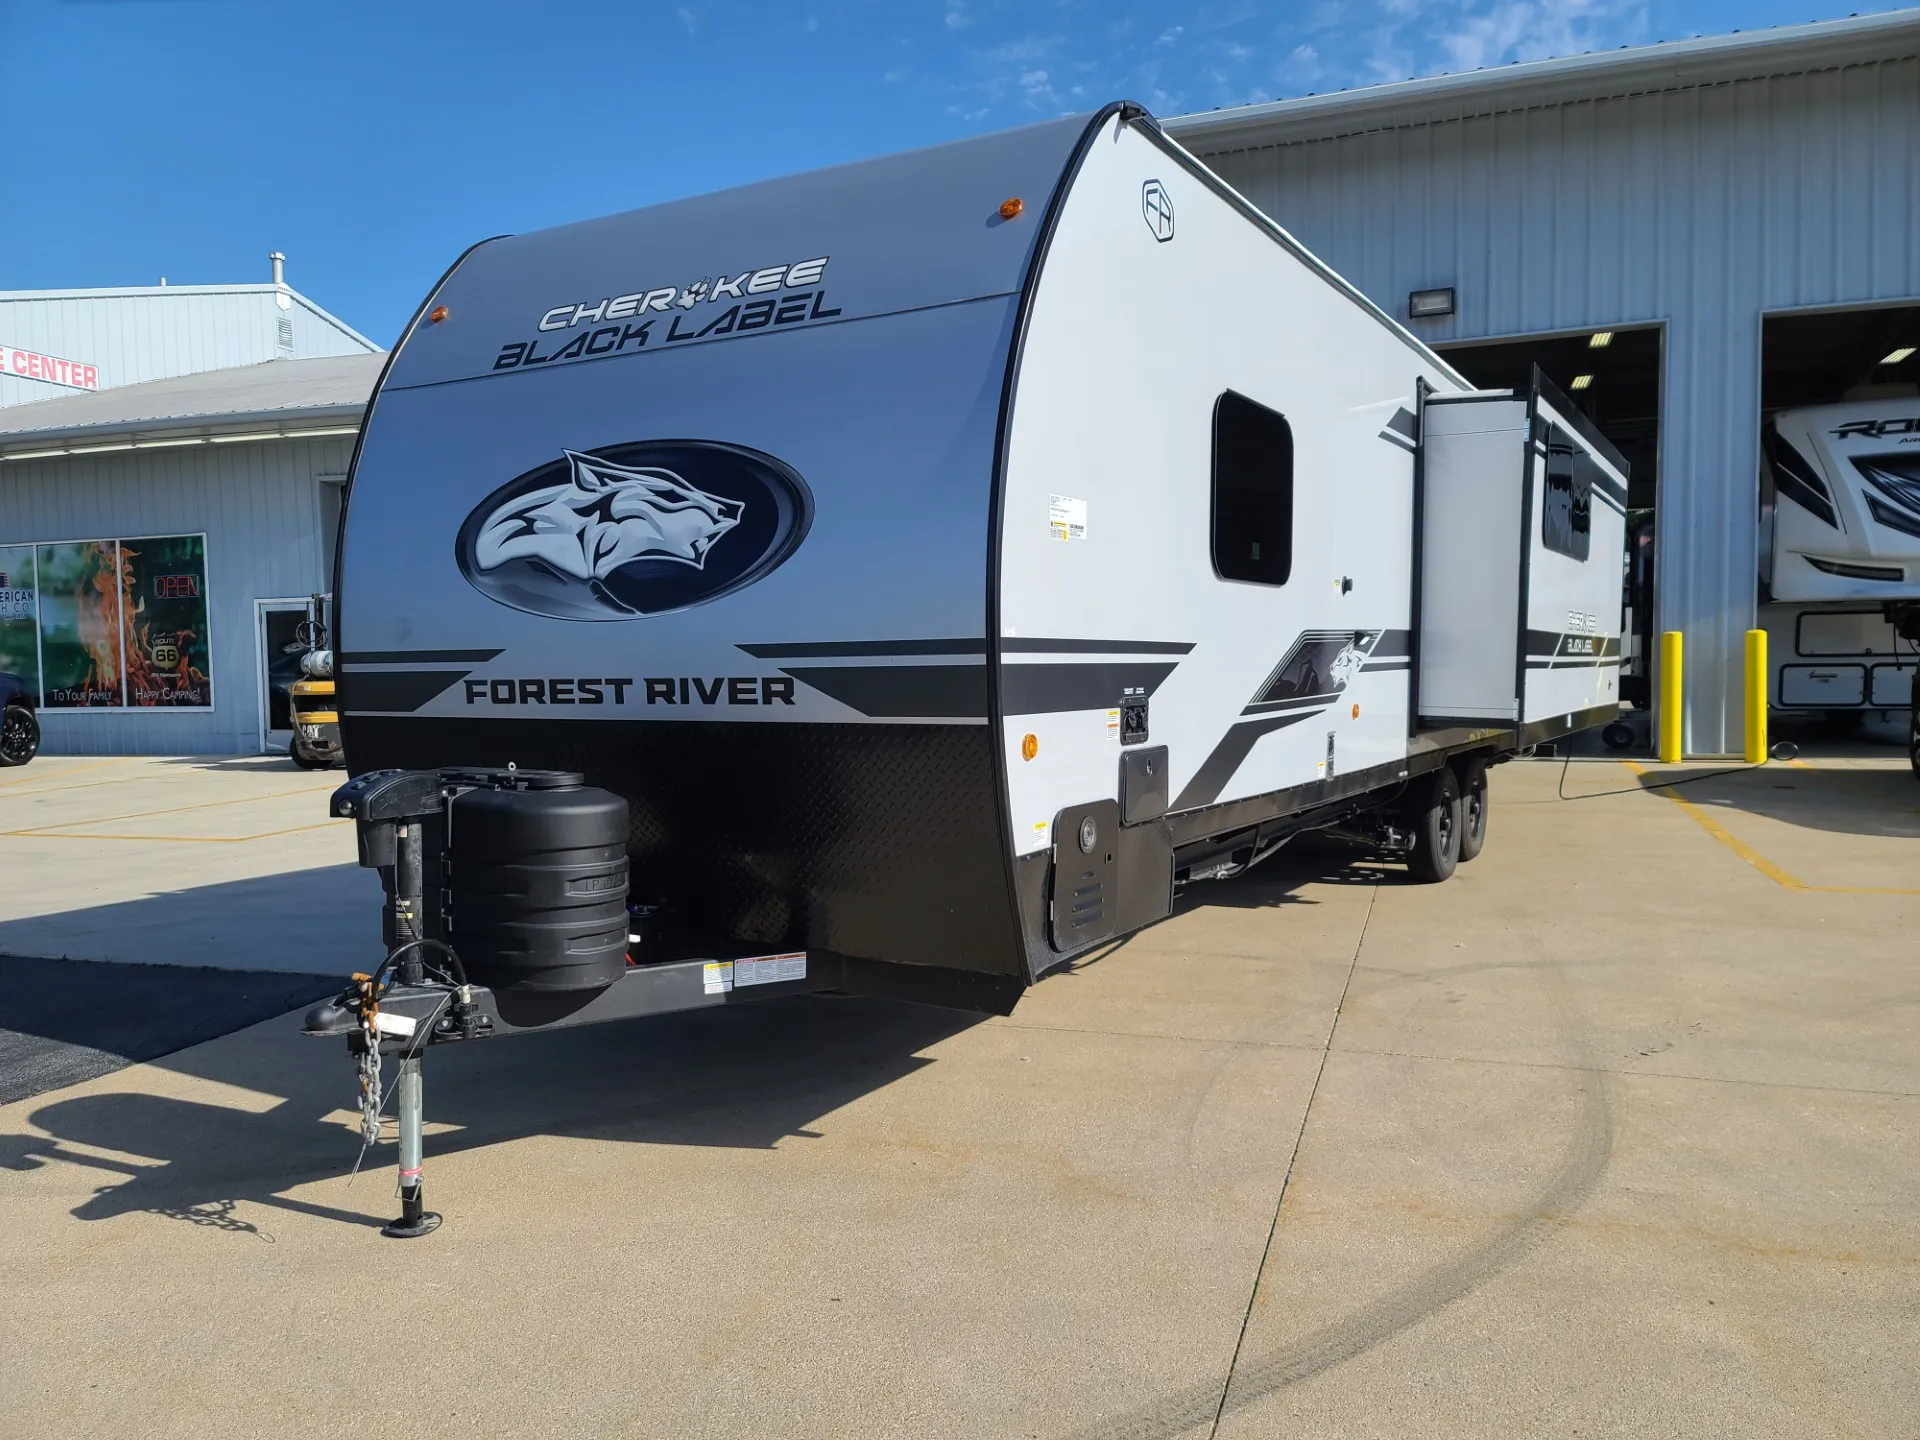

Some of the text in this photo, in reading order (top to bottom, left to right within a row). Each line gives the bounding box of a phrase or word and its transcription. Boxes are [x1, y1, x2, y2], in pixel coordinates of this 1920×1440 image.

[537, 255, 831, 332] CHEROKEE
[493, 290, 842, 370] BLACK LABEL
[12, 351, 97, 388] CENTER
[155, 575, 199, 597] OPEN
[155, 649, 177, 662] 66
[463, 677, 796, 705] FOREST RIVER
[302, 724, 319, 738] CAT
[585, 880, 600, 892] LP
